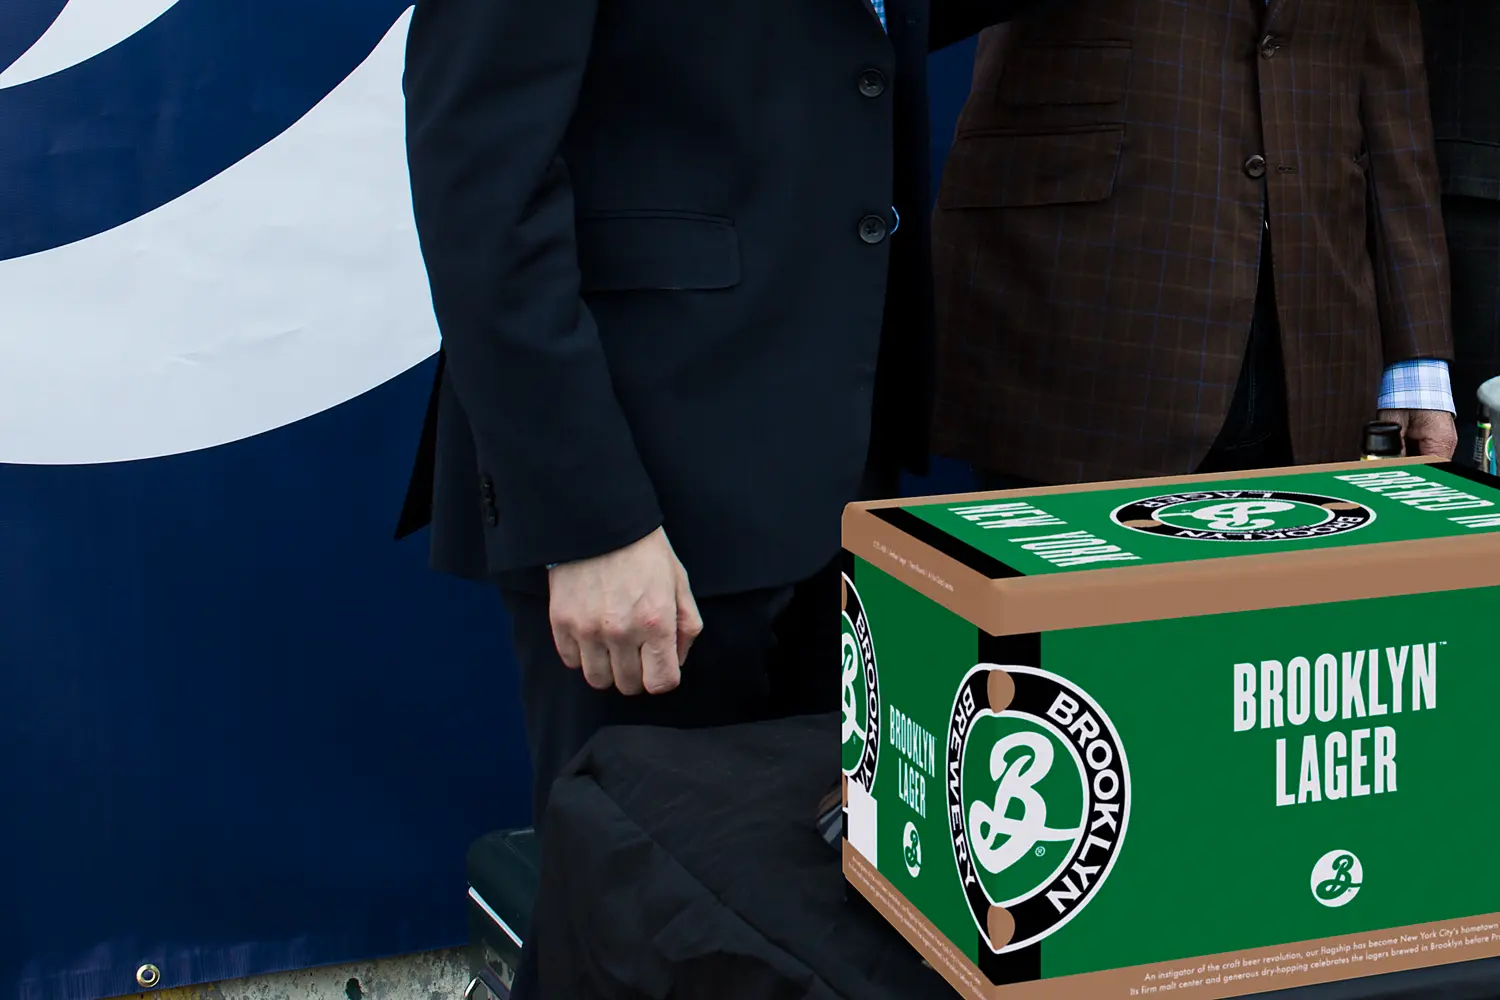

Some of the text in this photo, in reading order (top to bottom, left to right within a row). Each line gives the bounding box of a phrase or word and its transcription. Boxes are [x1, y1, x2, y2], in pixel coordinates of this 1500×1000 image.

[1136, 491, 1275, 509] LAGER
[1332, 470, 1496, 512] BREWED
[947, 501, 1143, 568] NEW YORK
[1173, 515, 1364, 541] BROOKLYN
[1234, 642, 1436, 732] BROOKLYN
[889, 704, 936, 778] BROOKLYN
[1276, 726, 1397, 807] LAGER
[898, 758, 926, 819] LAGER
[949, 684, 976, 888] BREWERY
[1045, 690, 1120, 914] BROOKLYN
[1130, 987, 1139, 996] Its
[1141, 984, 1157, 994] firm
[1159, 982, 1177, 992] malt
[1178, 978, 1204, 988] center
[1205, 974, 1221, 984] and
[1223, 971, 1260, 983] generous
[1261, 962, 1309, 977] dry-hopping
[1310, 956, 1350, 969] celebrates
[1351, 952, 1364, 961] the
[1365, 949, 1389, 961] lagers
[1391, 945, 1420, 956] brewed
[1430, 939, 1464, 950] Brooklyn
[1465, 935, 1489, 945] before
[1144, 973, 1156, 982] An
[1158, 967, 1195, 980] instigator
[1197, 965, 1206, 973] of
[1207, 963, 1220, 972] the
[1222, 960, 1241, 970] craft
[1242, 957, 1261, 967] beer
[1262, 951, 1304, 964] revolution,
[1305, 949, 1319, 957] our
[1320, 943, 1351, 956] flagship
[1353, 941, 1367, 950] has
[1368, 937, 1398, 948] become
[1400, 934, 1418, 943] New
[1420, 931, 1437, 939] York
[1439, 927, 1459, 939] City's
[1460, 923, 1499, 934] hometown
